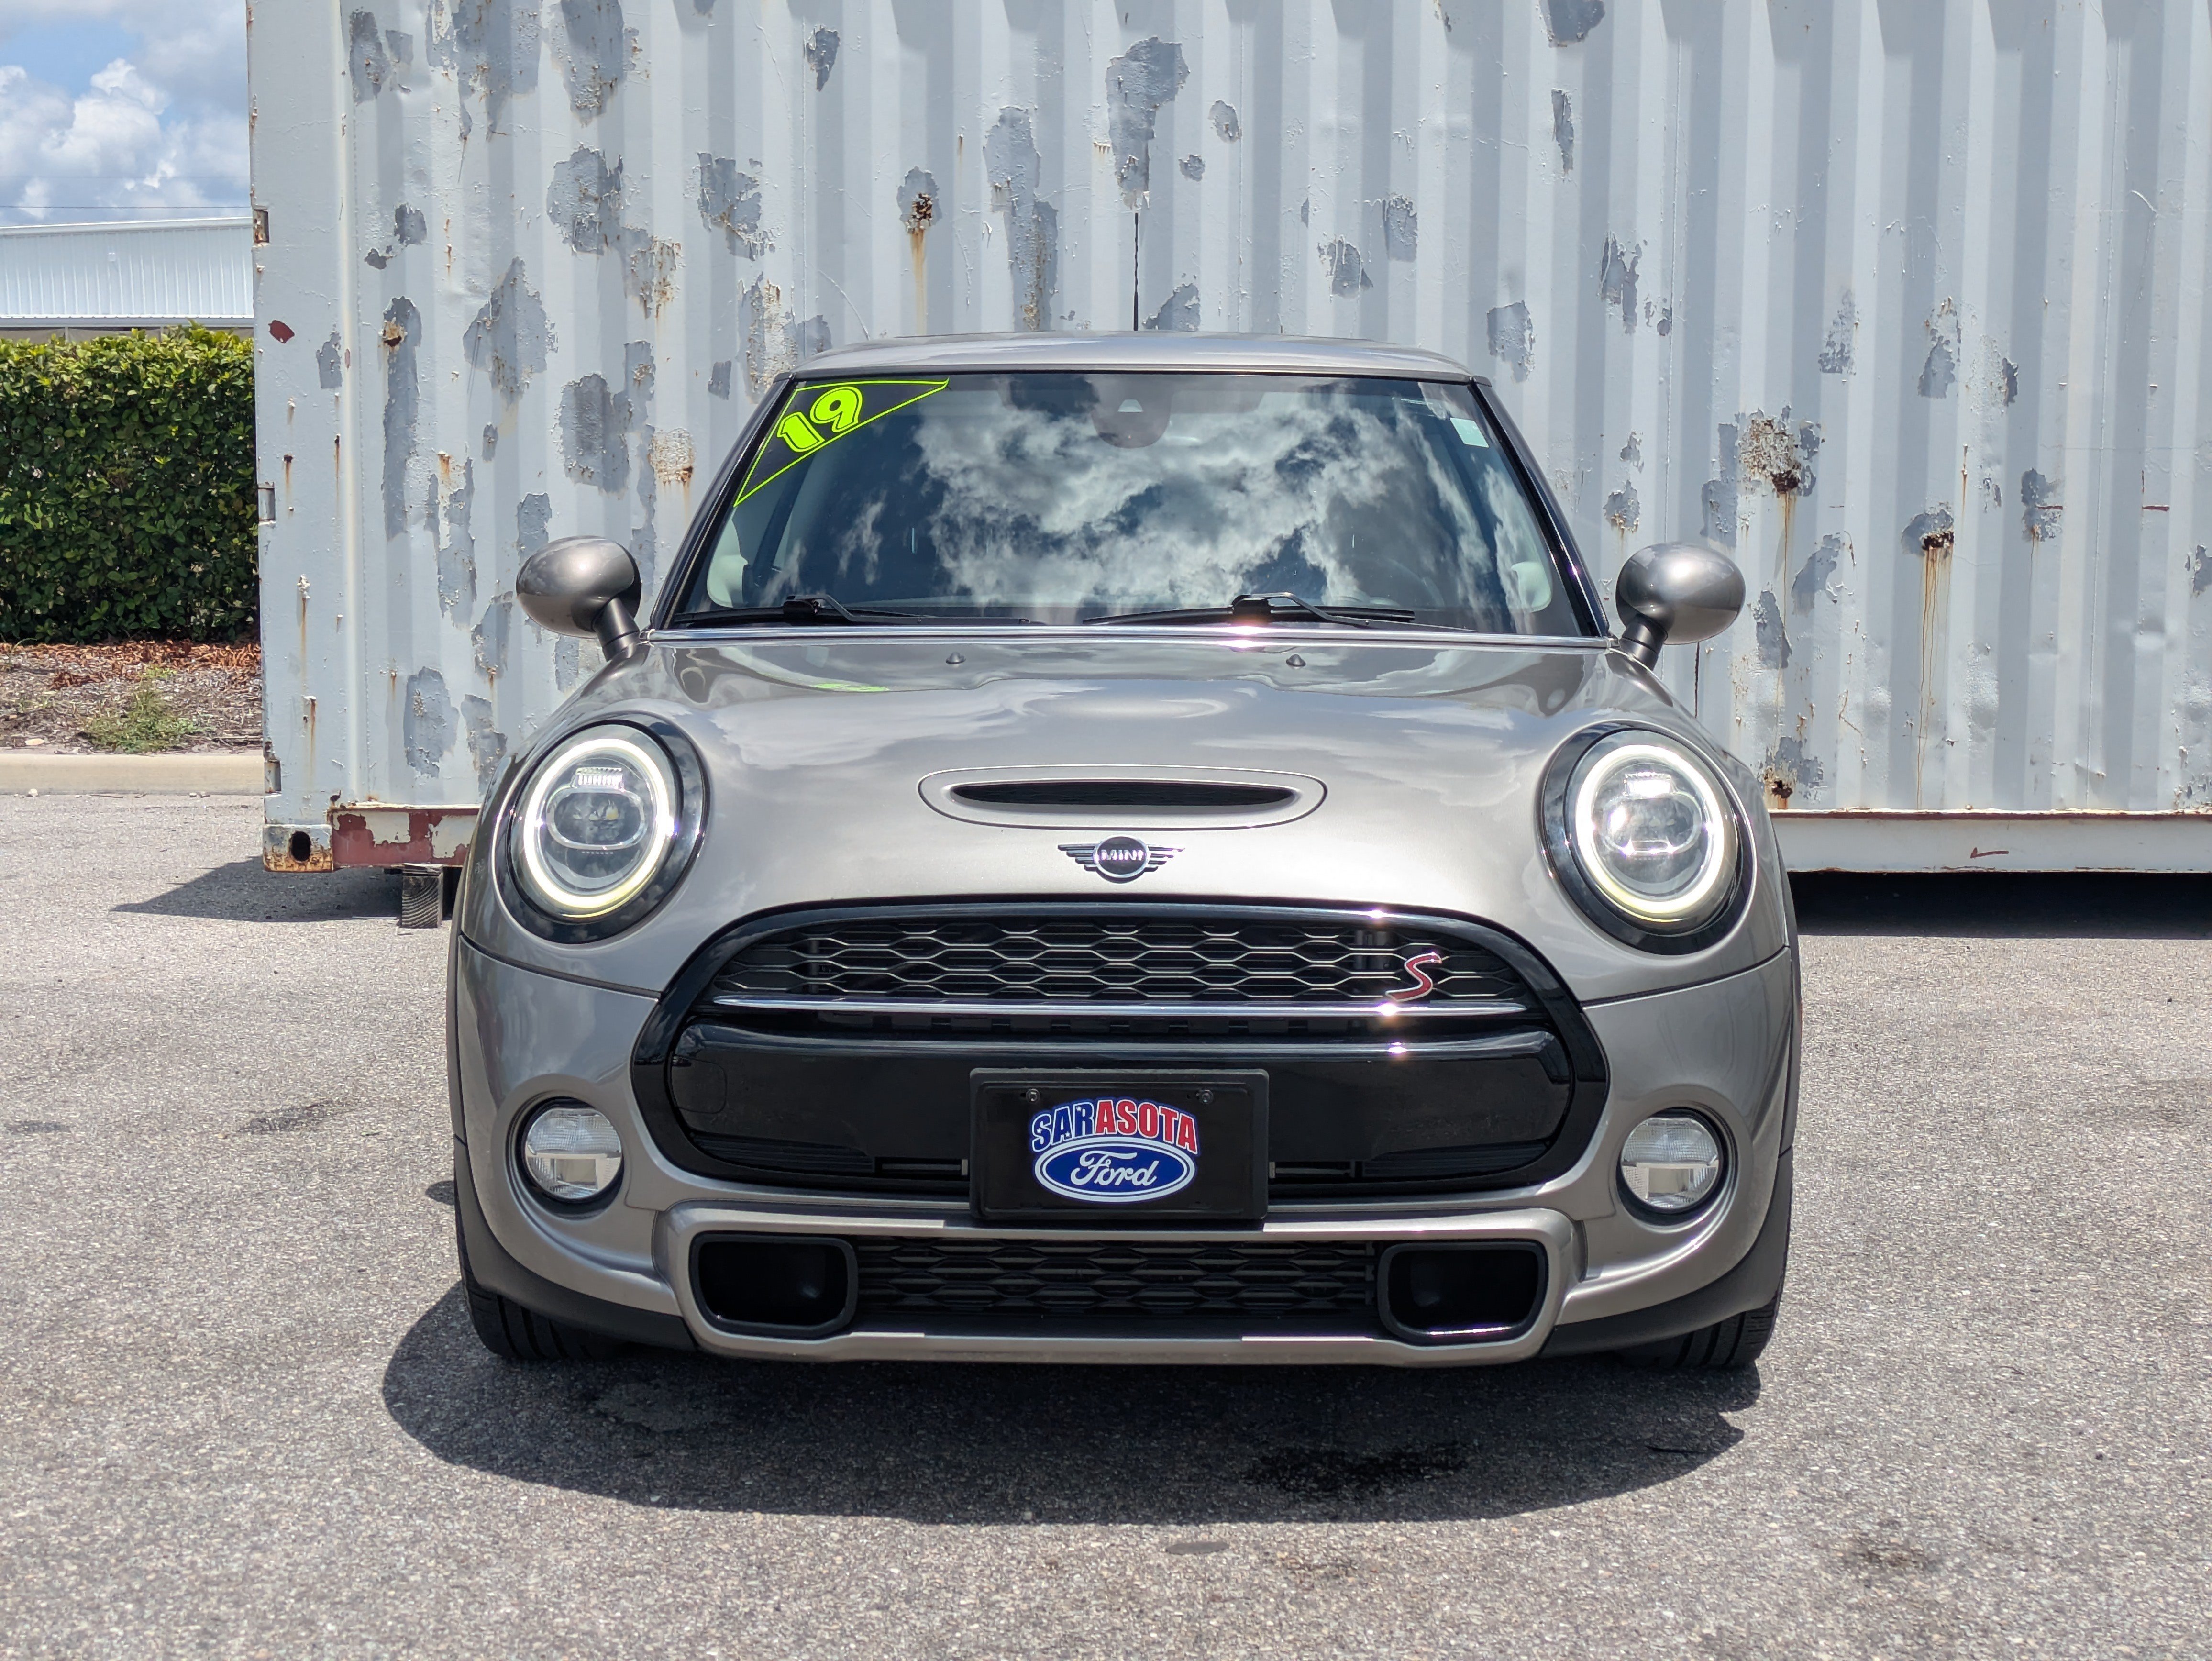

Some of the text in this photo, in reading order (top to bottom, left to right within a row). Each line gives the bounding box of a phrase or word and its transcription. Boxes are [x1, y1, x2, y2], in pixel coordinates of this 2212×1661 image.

[776, 386, 863, 452] 19
[1101, 849, 1144, 861] MINI
[1385, 952, 1442, 1002] S
[1031, 1099, 1198, 1155] SARASOTA
[1070, 1150, 1160, 1186] Ford
